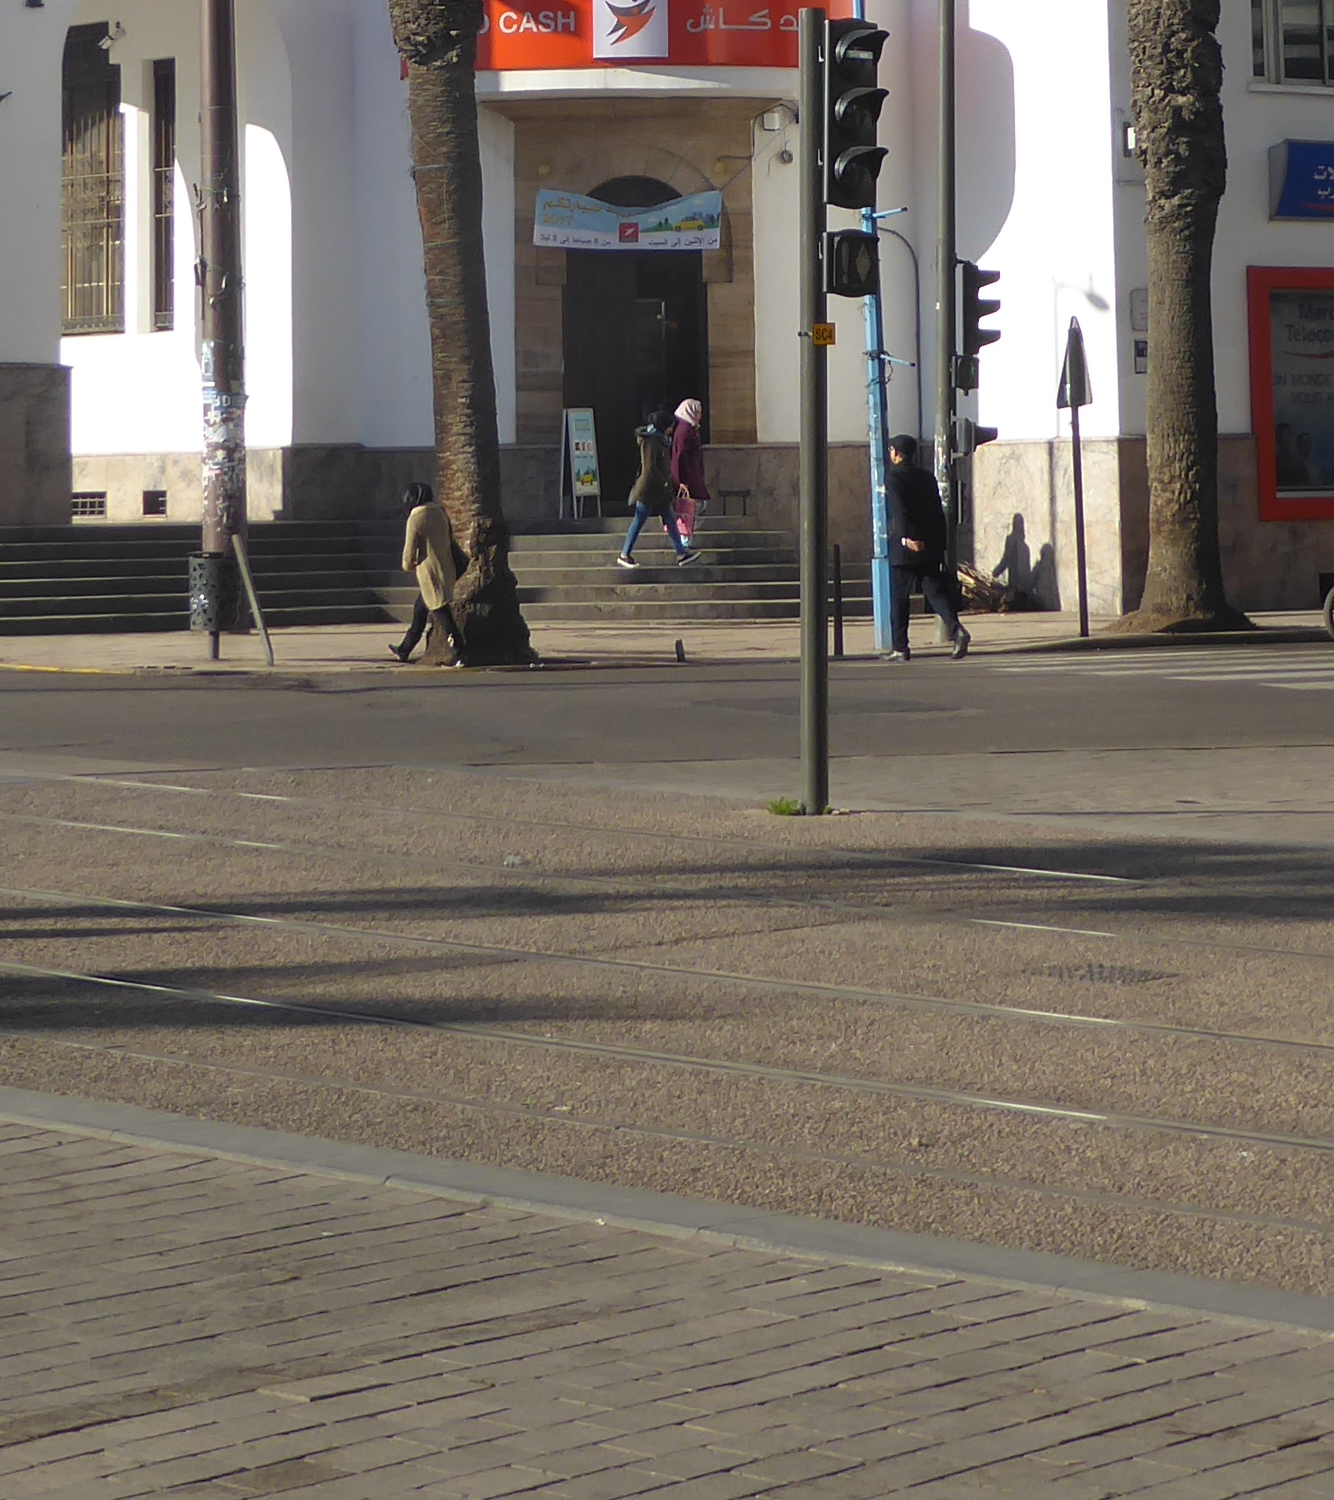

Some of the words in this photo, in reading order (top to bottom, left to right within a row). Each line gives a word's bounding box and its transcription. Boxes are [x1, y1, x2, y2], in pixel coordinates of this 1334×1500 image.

[498, 10, 576, 34] CASH
[686, 3, 773, 33] كاش
[815, 328, 833, 341] SC4
[1291, 373, 1333, 387] MONDE
